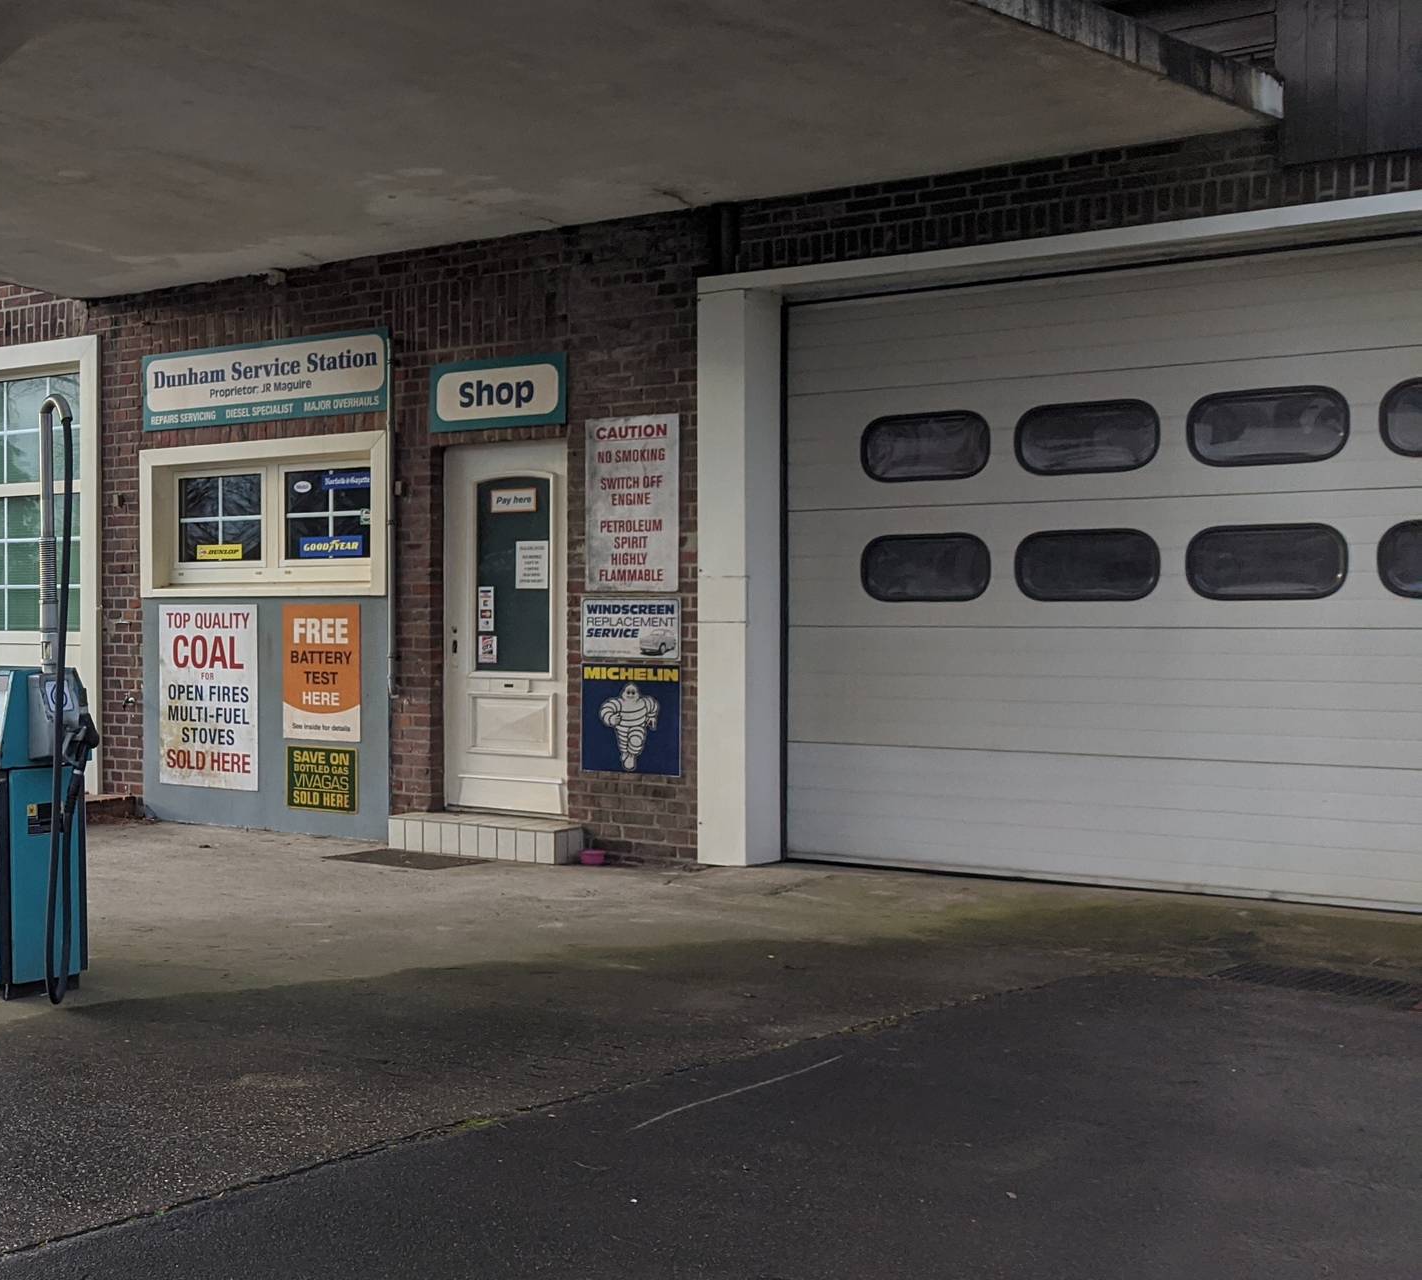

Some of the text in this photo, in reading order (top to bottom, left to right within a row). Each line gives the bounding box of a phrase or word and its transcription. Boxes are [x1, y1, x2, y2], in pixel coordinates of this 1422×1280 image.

[153, 349, 378, 390] Dunham Service Station
[209, 378, 312, 400] Proprietor: JR Maguire
[459, 379, 535, 409] Shop
[225, 403, 294, 419] DIESEL SPECIALIST
[303, 396, 380, 412] MAJOR OVERHAULS
[150, 411, 216, 426] REPAIRS SERVICING
[595, 424, 668, 440] CAUTION
[597, 448, 666, 464] NO SMOKING
[600, 475, 663, 491] SWITCH OFF
[496, 495, 532, 506] Pay here
[611, 492, 651, 506] ENGINE
[600, 519, 663, 534] PETROLEUM
[303, 539, 359, 552] GOODYEAR
[613, 536, 648, 550] SPIRIT
[610, 552, 648, 566] HIGHLY
[599, 568, 664, 582] FLAMMABLE
[586, 604, 675, 615] WINDSCREEN
[166, 612, 250, 630] TOP QUALITY
[586, 616, 676, 627] REPLACEMENT
[293, 617, 349, 645] FREE
[585, 627, 640, 639] SERVICE
[172, 634, 244, 670] COAL
[290, 650, 353, 664] BATTERY
[200, 672, 215, 681] FOR
[304, 671, 339, 685] TEST
[583, 666, 679, 682] MICHELIN
[168, 684, 250, 704] OPEN FIRES
[302, 691, 340, 706] HERE
[168, 705, 250, 725] MULTI-FUEL
[291, 722, 351, 732] See inside for details
[181, 726, 236, 746] STOVES
[166, 749, 252, 774] SOLD HERE
[293, 750, 350, 766] SAVE ON
[293, 763, 350, 775] BOTTLED GAS
[293, 772, 350, 791] VIVAGAS
[293, 790, 350, 808] SOLD HERE
